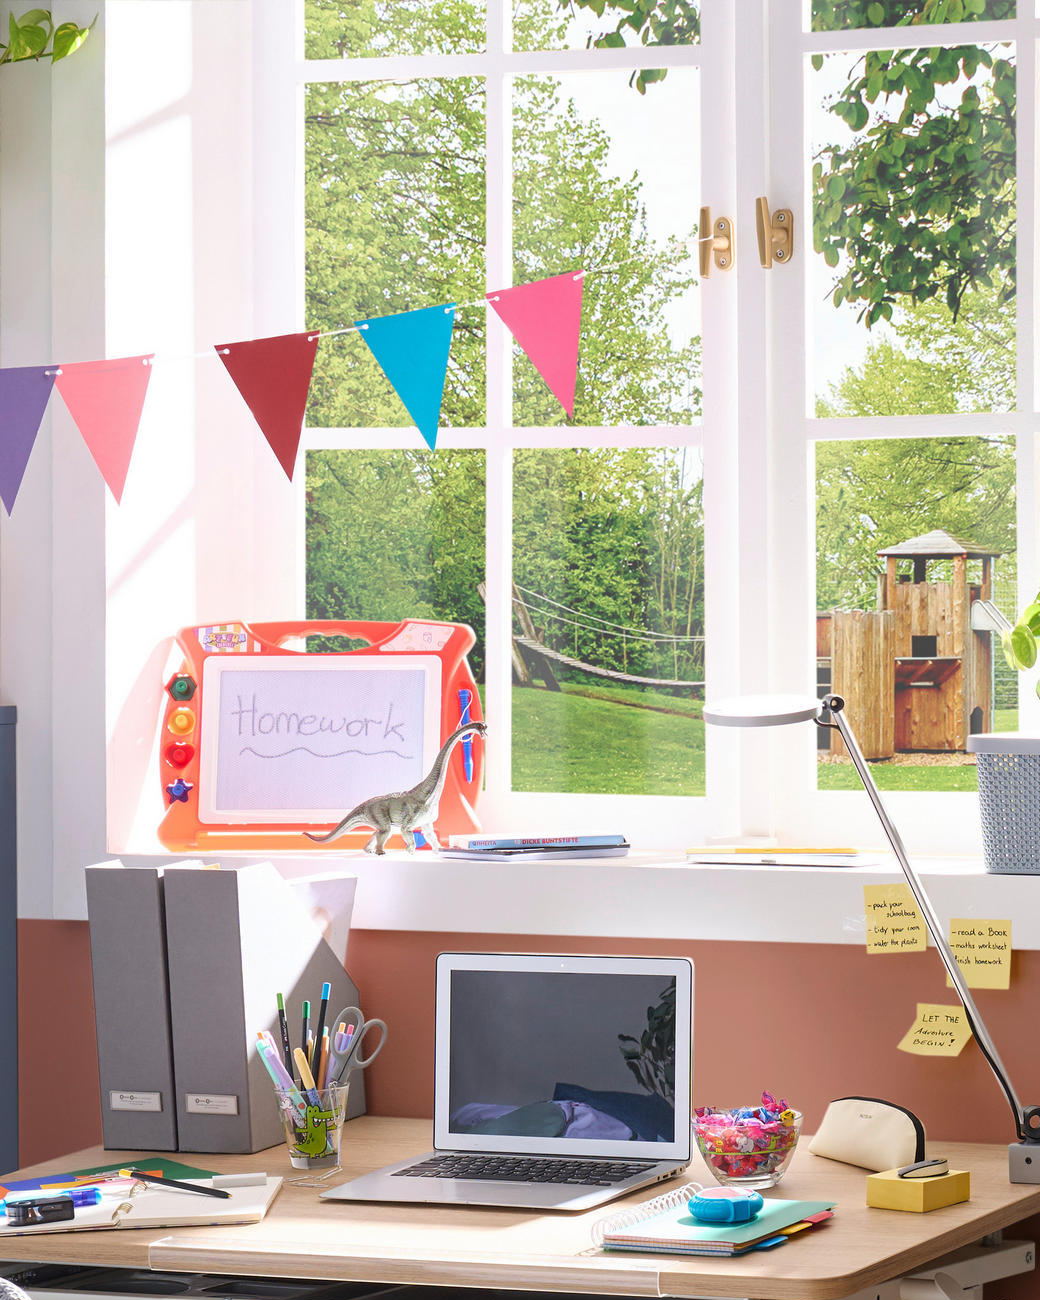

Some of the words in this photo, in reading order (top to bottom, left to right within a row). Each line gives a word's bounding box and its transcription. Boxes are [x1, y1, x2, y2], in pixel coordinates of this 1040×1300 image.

[231, 693, 405, 742] Homework
[542, 837, 578, 845] BUNTSTIFTE
[873, 900, 887, 910] pack
[889, 902, 902, 910] your
[886, 910, 916, 918] schoolbag
[874, 926, 888, 935] tidy
[958, 928, 976, 936] read
[988, 927, 1007, 937] Book
[978, 942, 1007, 950] worksheet
[975, 956, 1003, 965] homework
[922, 1014, 940, 1022] LET
[945, 1015, 959, 1024] THE
